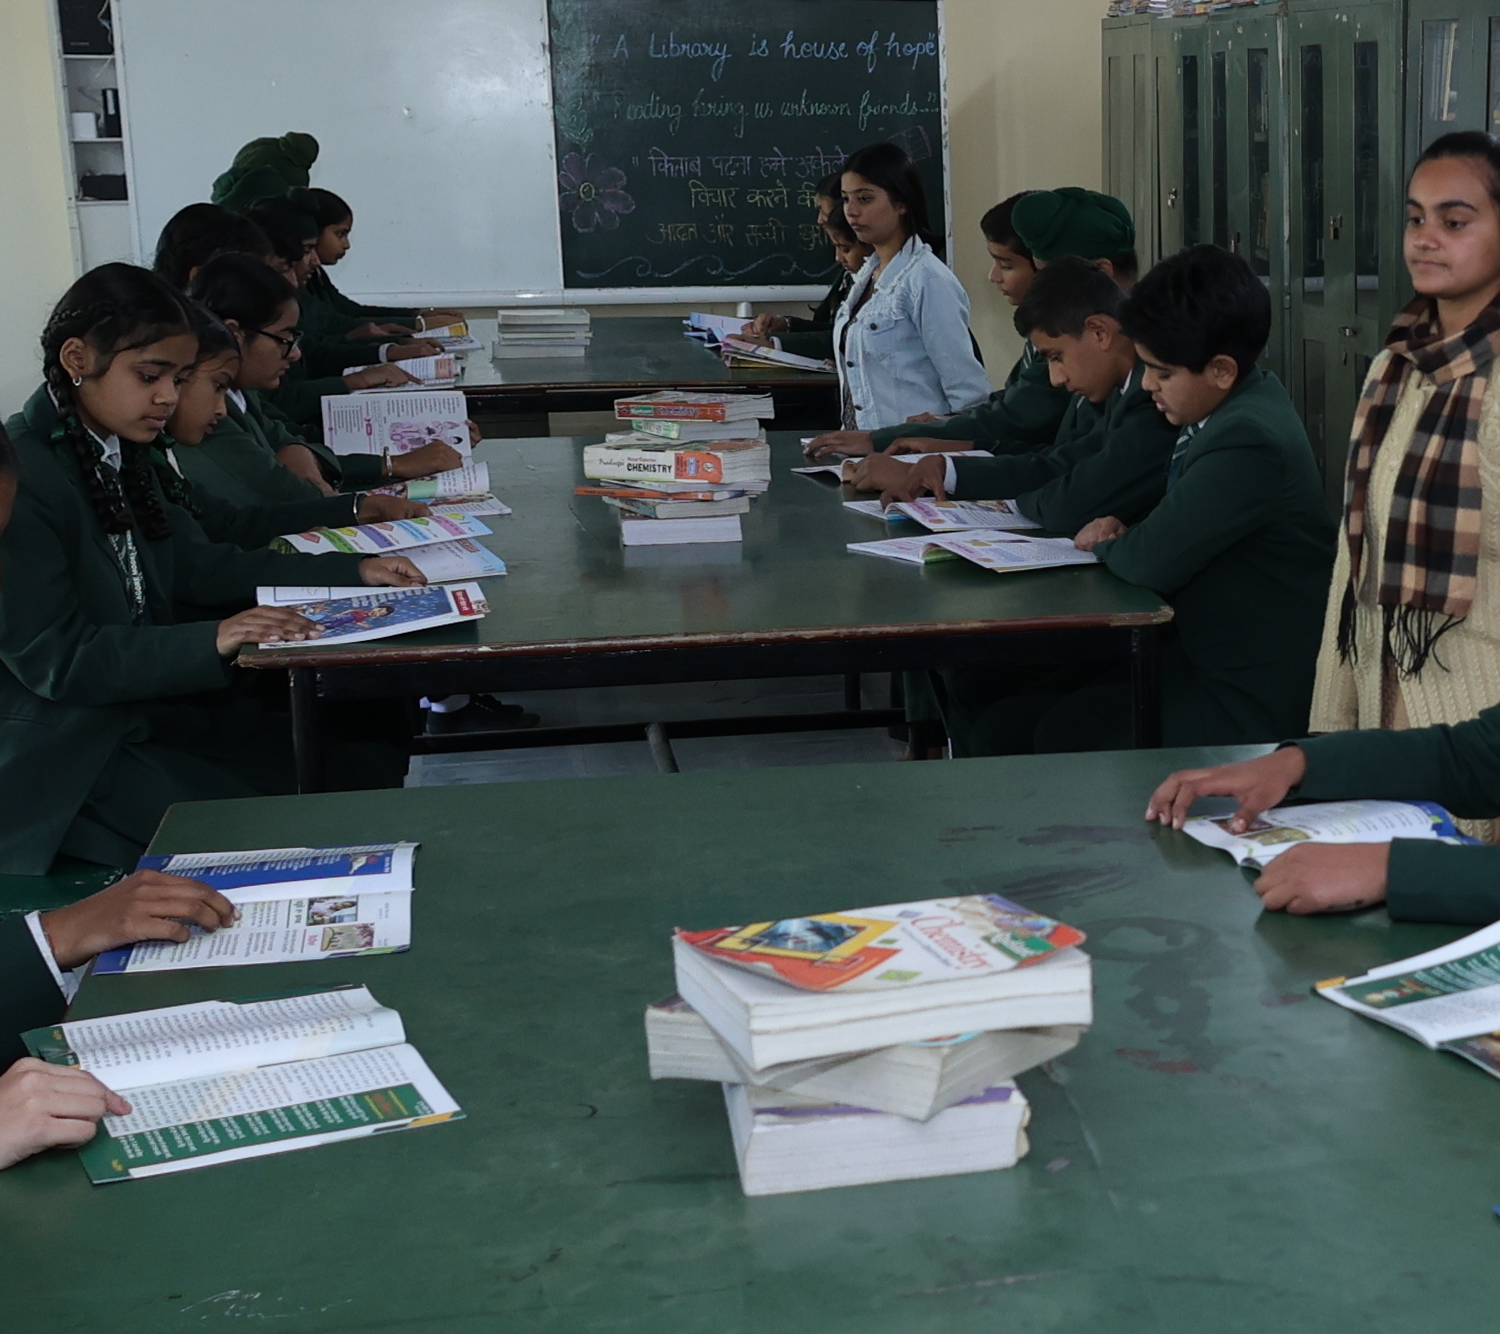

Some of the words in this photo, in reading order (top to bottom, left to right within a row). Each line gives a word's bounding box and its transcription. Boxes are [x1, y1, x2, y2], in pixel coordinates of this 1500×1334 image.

[649, 31, 732, 82] Library
[749, 33, 770, 58] is
[779, 30, 849, 61] house
[856, 30, 879, 73] of
[780, 88, 851, 117] unknown
[648, 146, 701, 178] किताब
[689, 179, 740, 208] विचार
[747, 179, 789, 208] करने
[626, 462, 674, 475] CHEMISTRY
